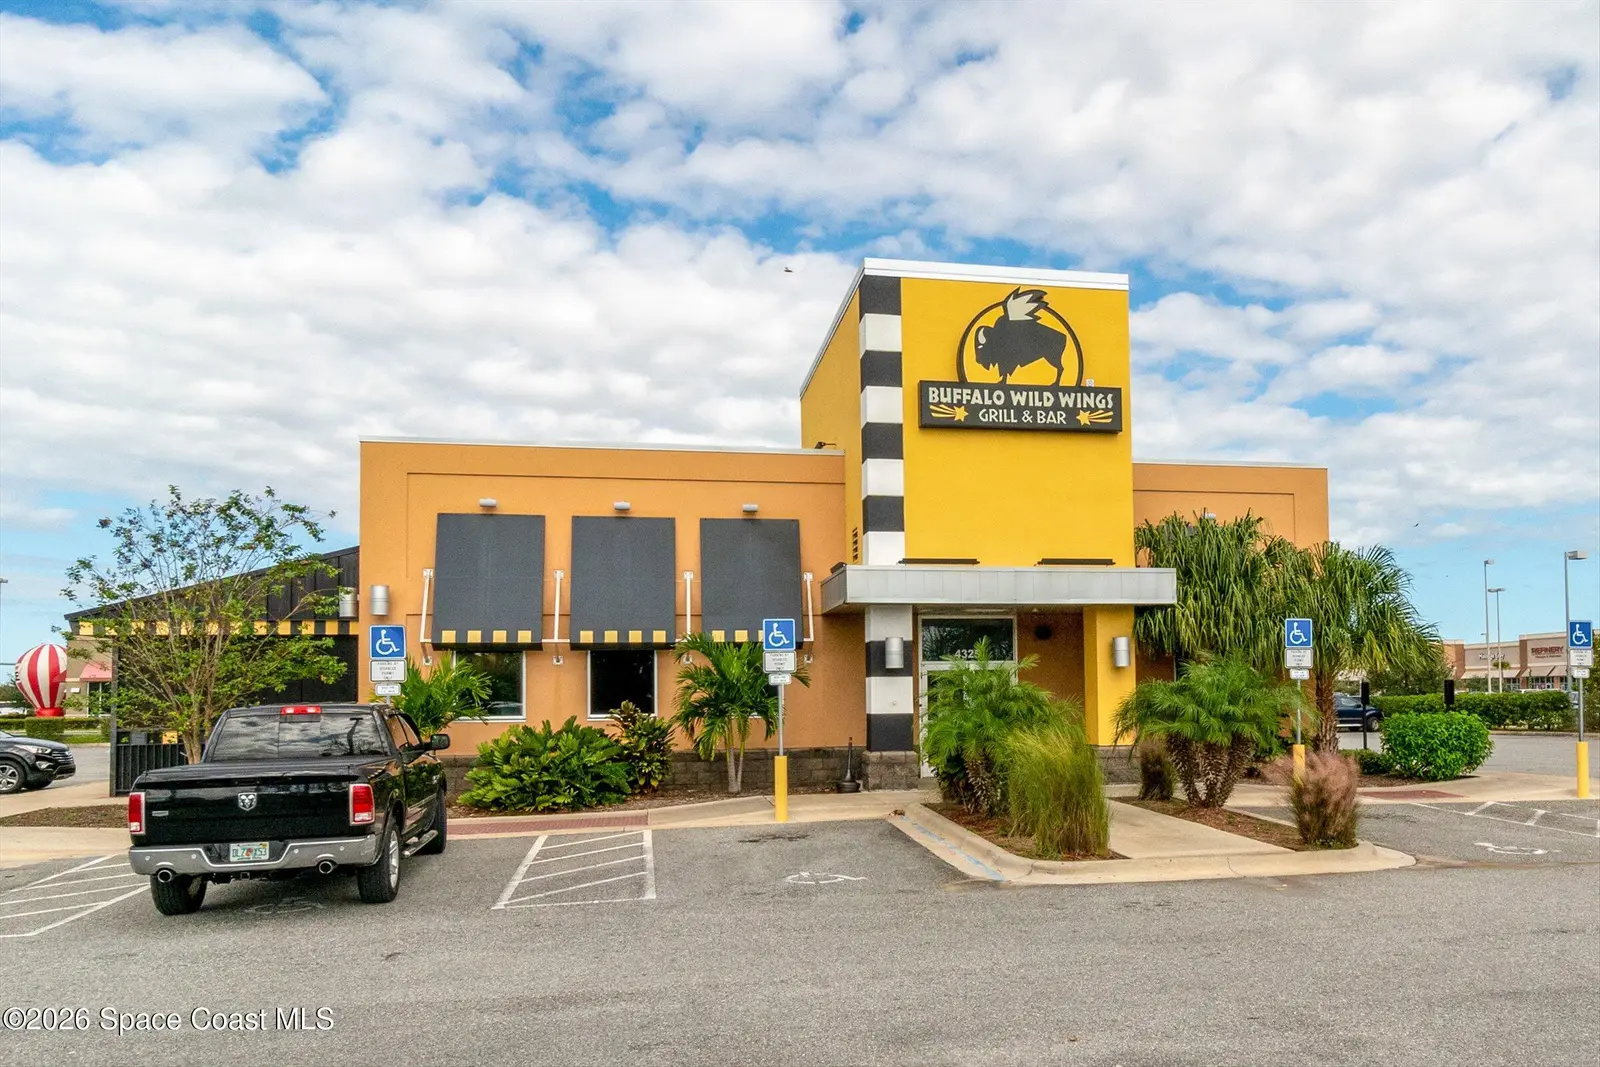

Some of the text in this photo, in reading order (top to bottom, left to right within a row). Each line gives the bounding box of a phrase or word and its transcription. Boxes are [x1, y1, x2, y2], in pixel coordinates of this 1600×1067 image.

[928, 387, 1113, 409] BUFFALO WILD WINGS
[979, 408, 1067, 424] GRILL & BAR
